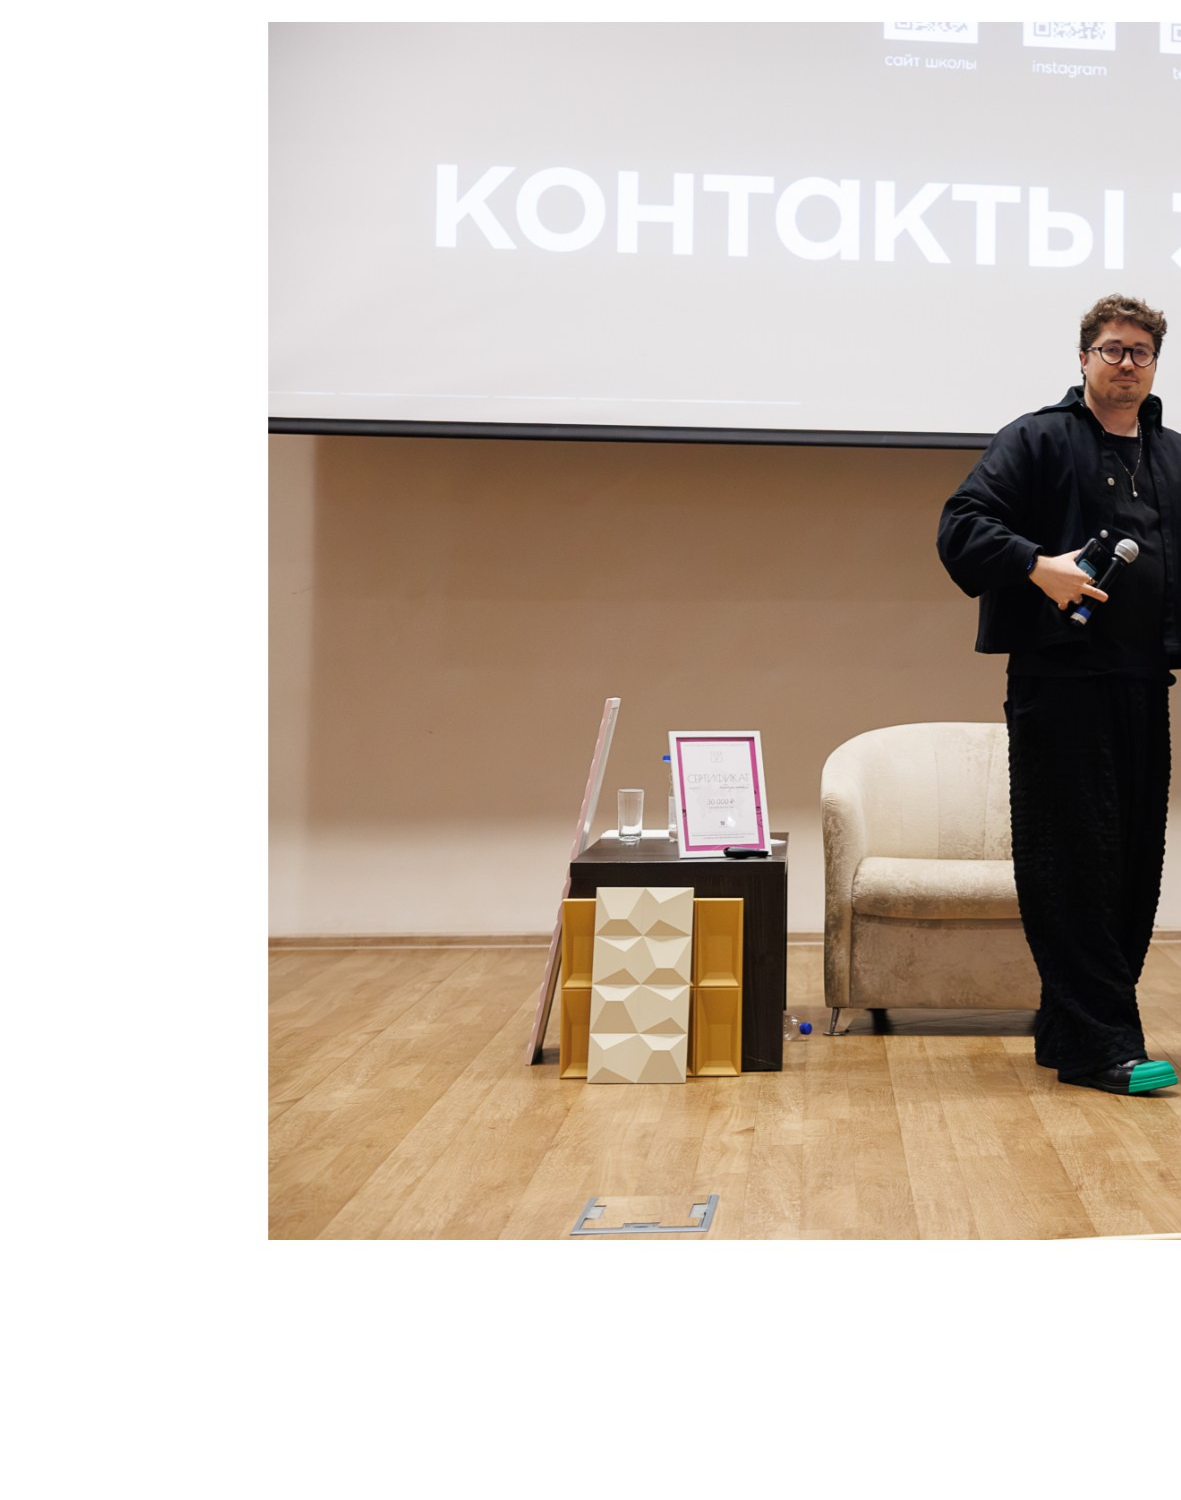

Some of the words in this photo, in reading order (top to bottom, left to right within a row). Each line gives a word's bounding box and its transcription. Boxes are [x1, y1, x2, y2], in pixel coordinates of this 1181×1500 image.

[884, 53, 920, 68] сайт
[925, 57, 978, 71] школы
[1032, 60, 1108, 78] instagram
[687, 773, 749, 784] СЕРТИФИКАТ
